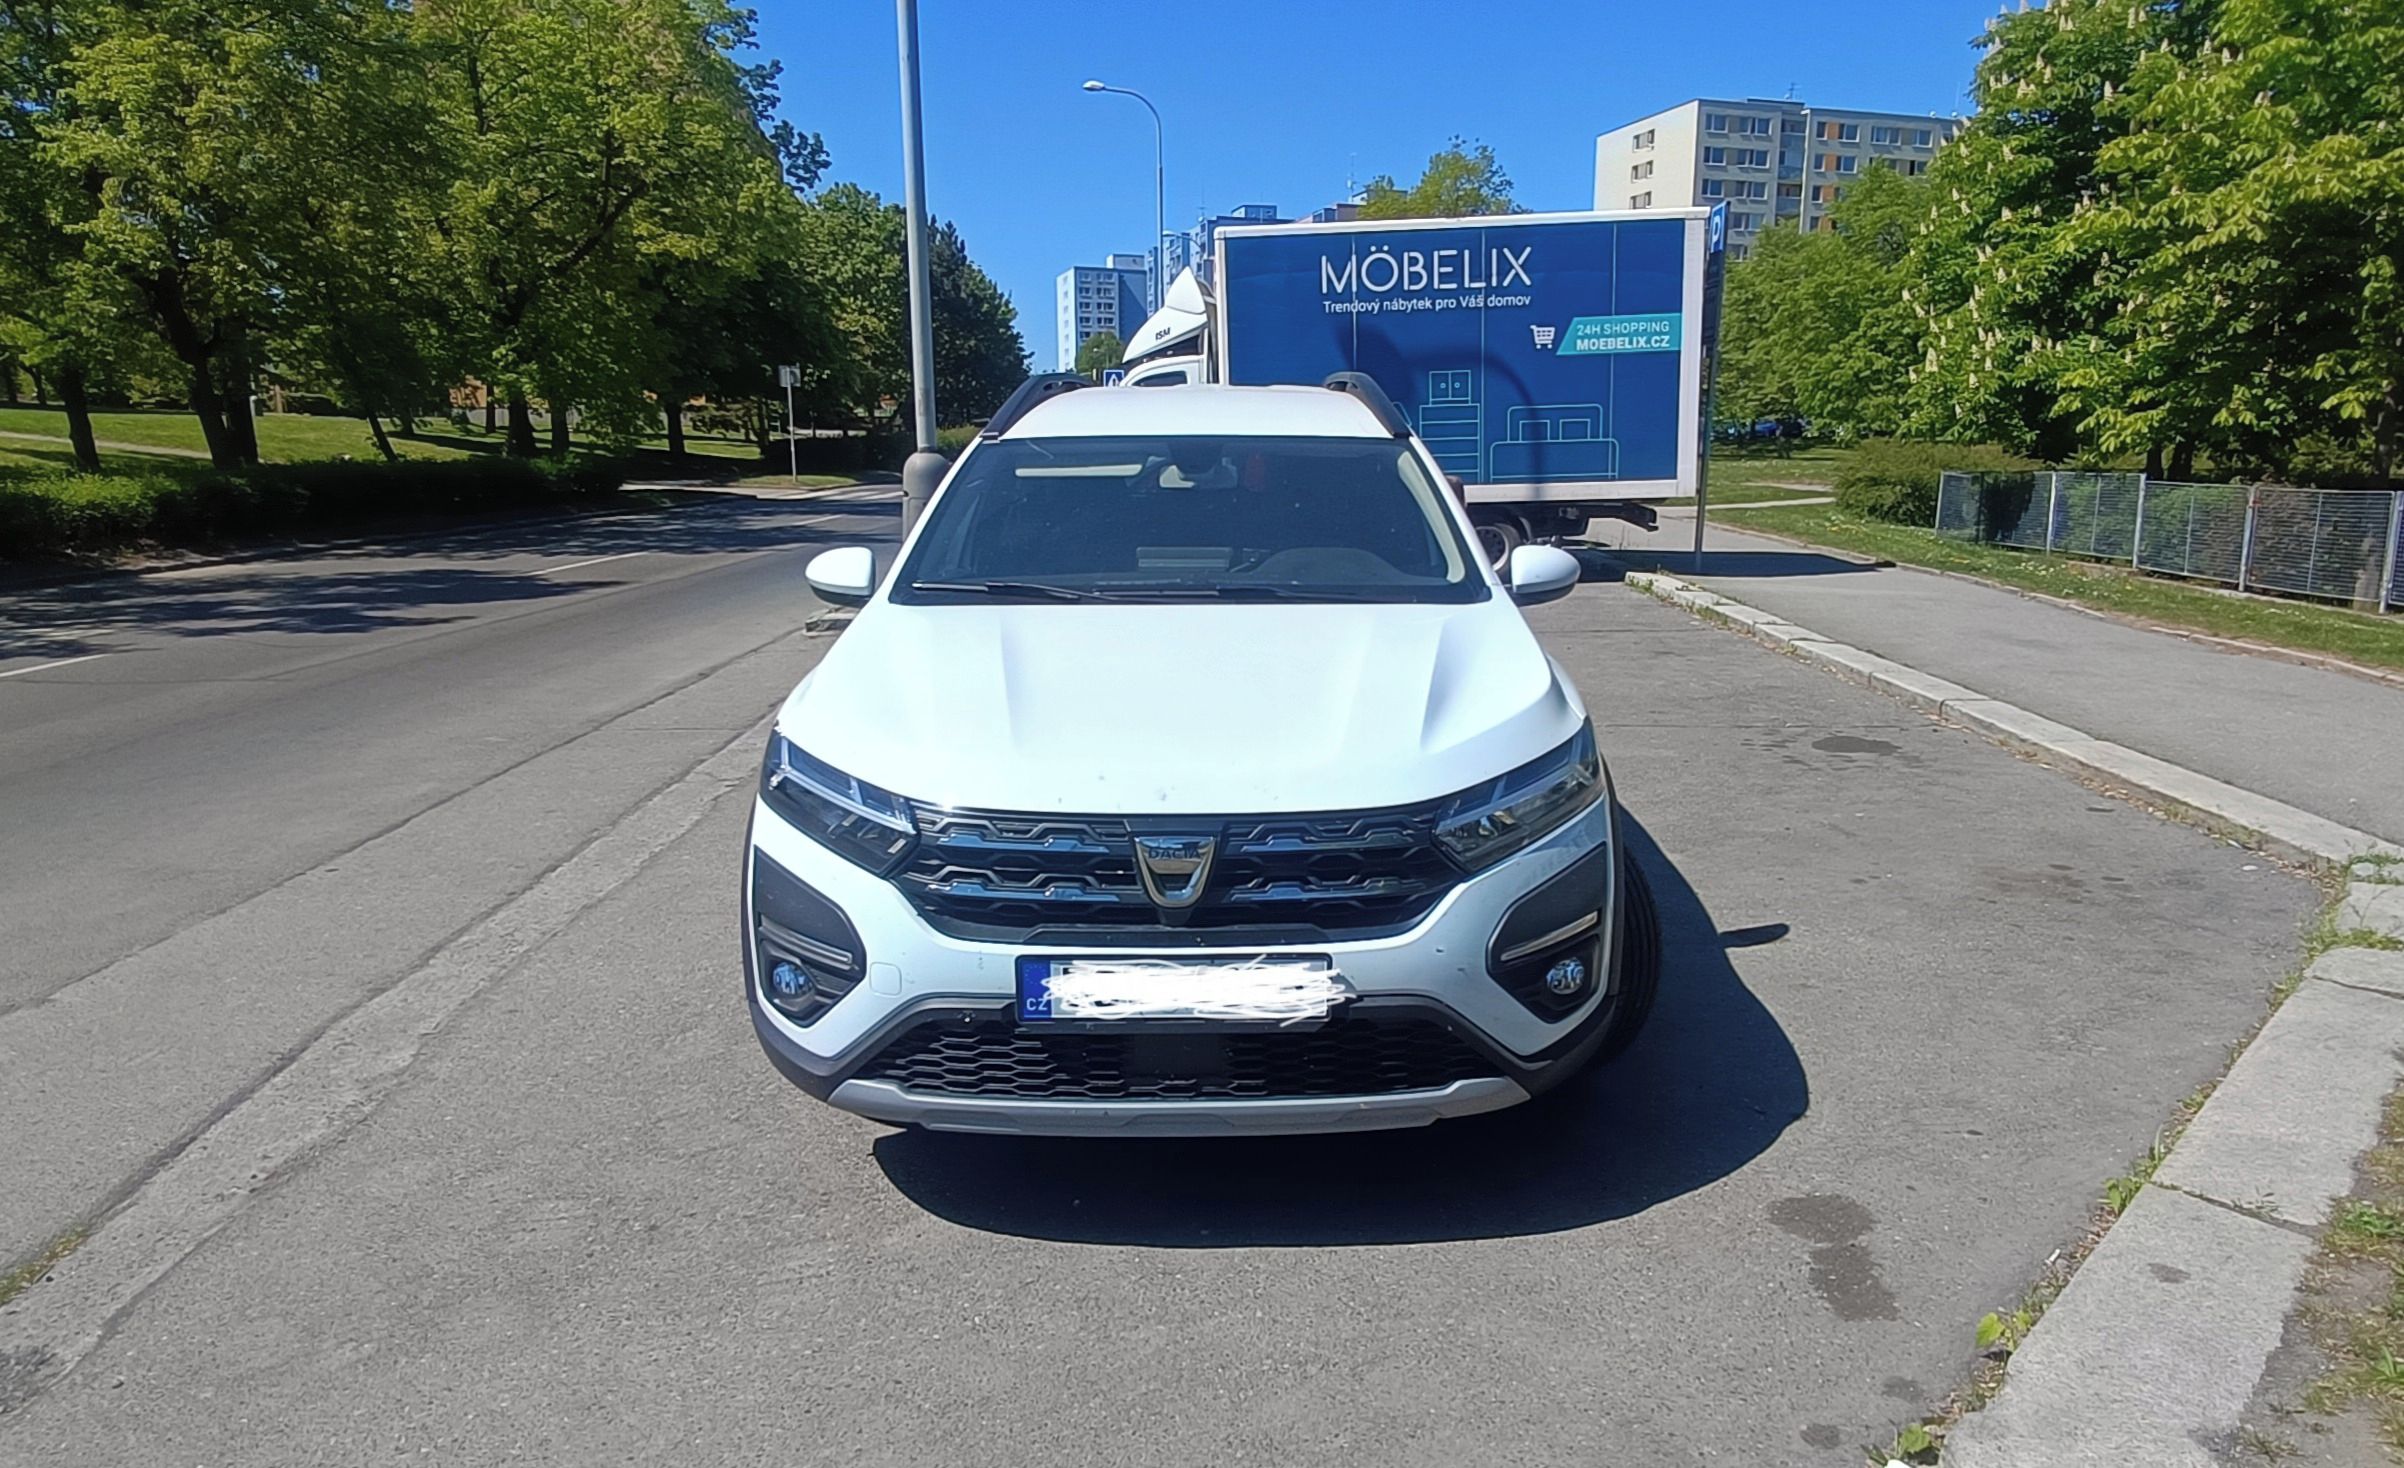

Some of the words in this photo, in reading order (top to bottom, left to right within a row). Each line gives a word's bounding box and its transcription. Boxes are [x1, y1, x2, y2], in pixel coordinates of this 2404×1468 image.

[1321, 245, 1532, 294] MÖBELIX
[1323, 299, 1380, 315] Trendový
[1383, 297, 1433, 313] nábytek
[1435, 299, 1457, 312] pro
[1459, 294, 1485, 308] Váš
[1487, 294, 1532, 308] domov
[1576, 324, 1600, 336] 24H
[1603, 321, 1670, 335] SHOPPING
[1576, 336, 1670, 351] MOEBELIX.CZ
[1148, 847, 1201, 859] DACIA
[1026, 997, 1048, 1011] CZ
